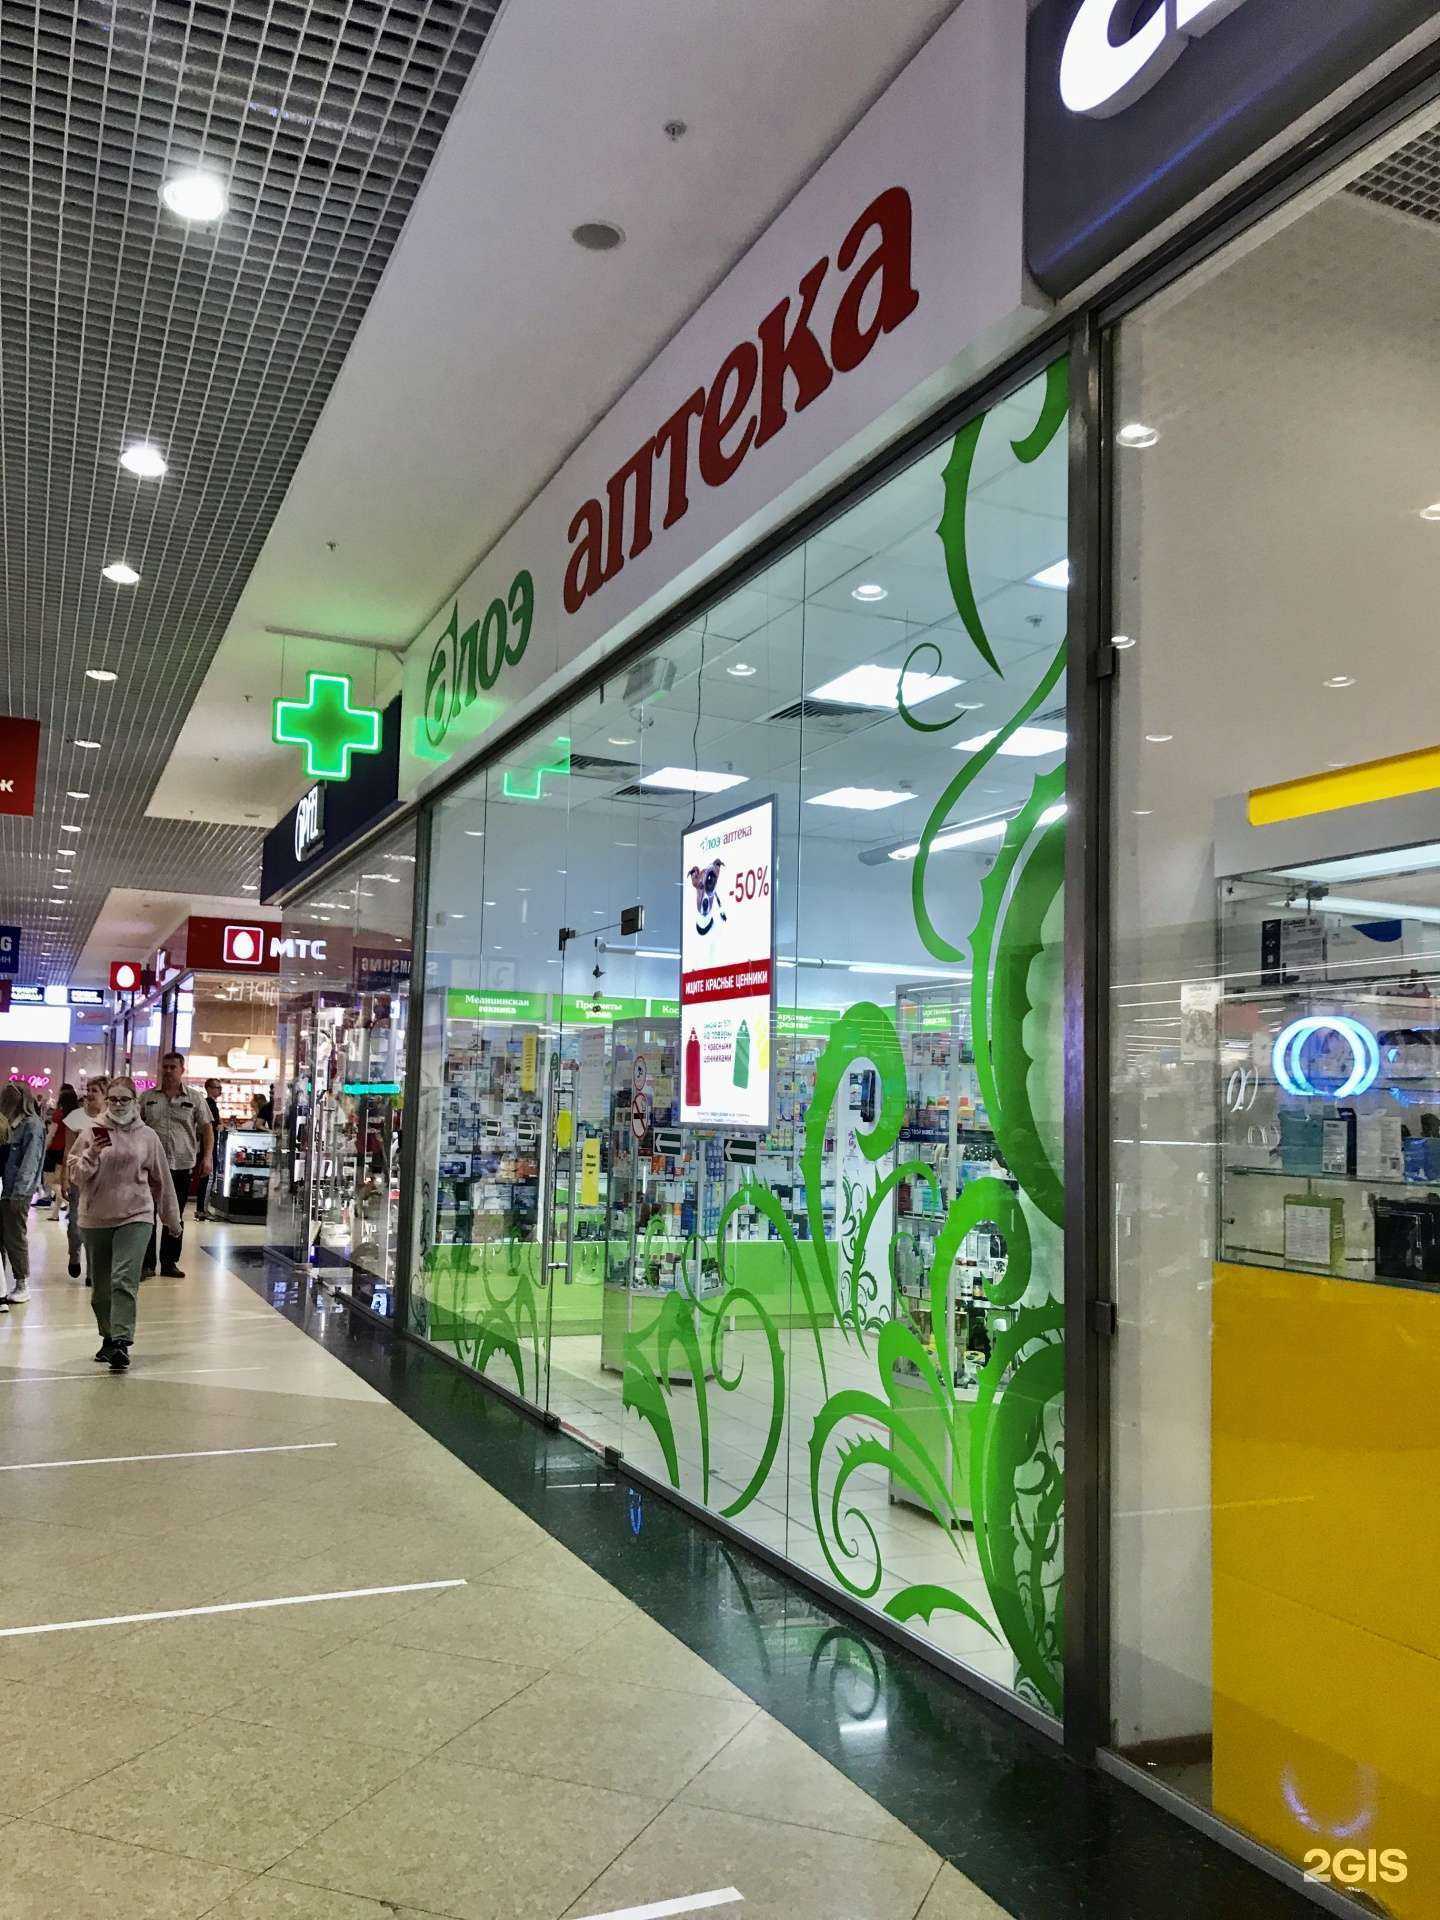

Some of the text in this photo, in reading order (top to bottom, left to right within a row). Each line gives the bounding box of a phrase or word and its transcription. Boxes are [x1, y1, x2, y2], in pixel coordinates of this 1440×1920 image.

[563, 186, 919, 614] аптека
[723, 825, 753, 845] аптека
[729, 865, 770, 903] -50%
[269, 937, 327, 960] МТС
[685, 971, 768, 995] ИЩИТЕ КРАСНЫЕ ЦЕННИКИ
[662, 1005, 680, 1014] Кос
